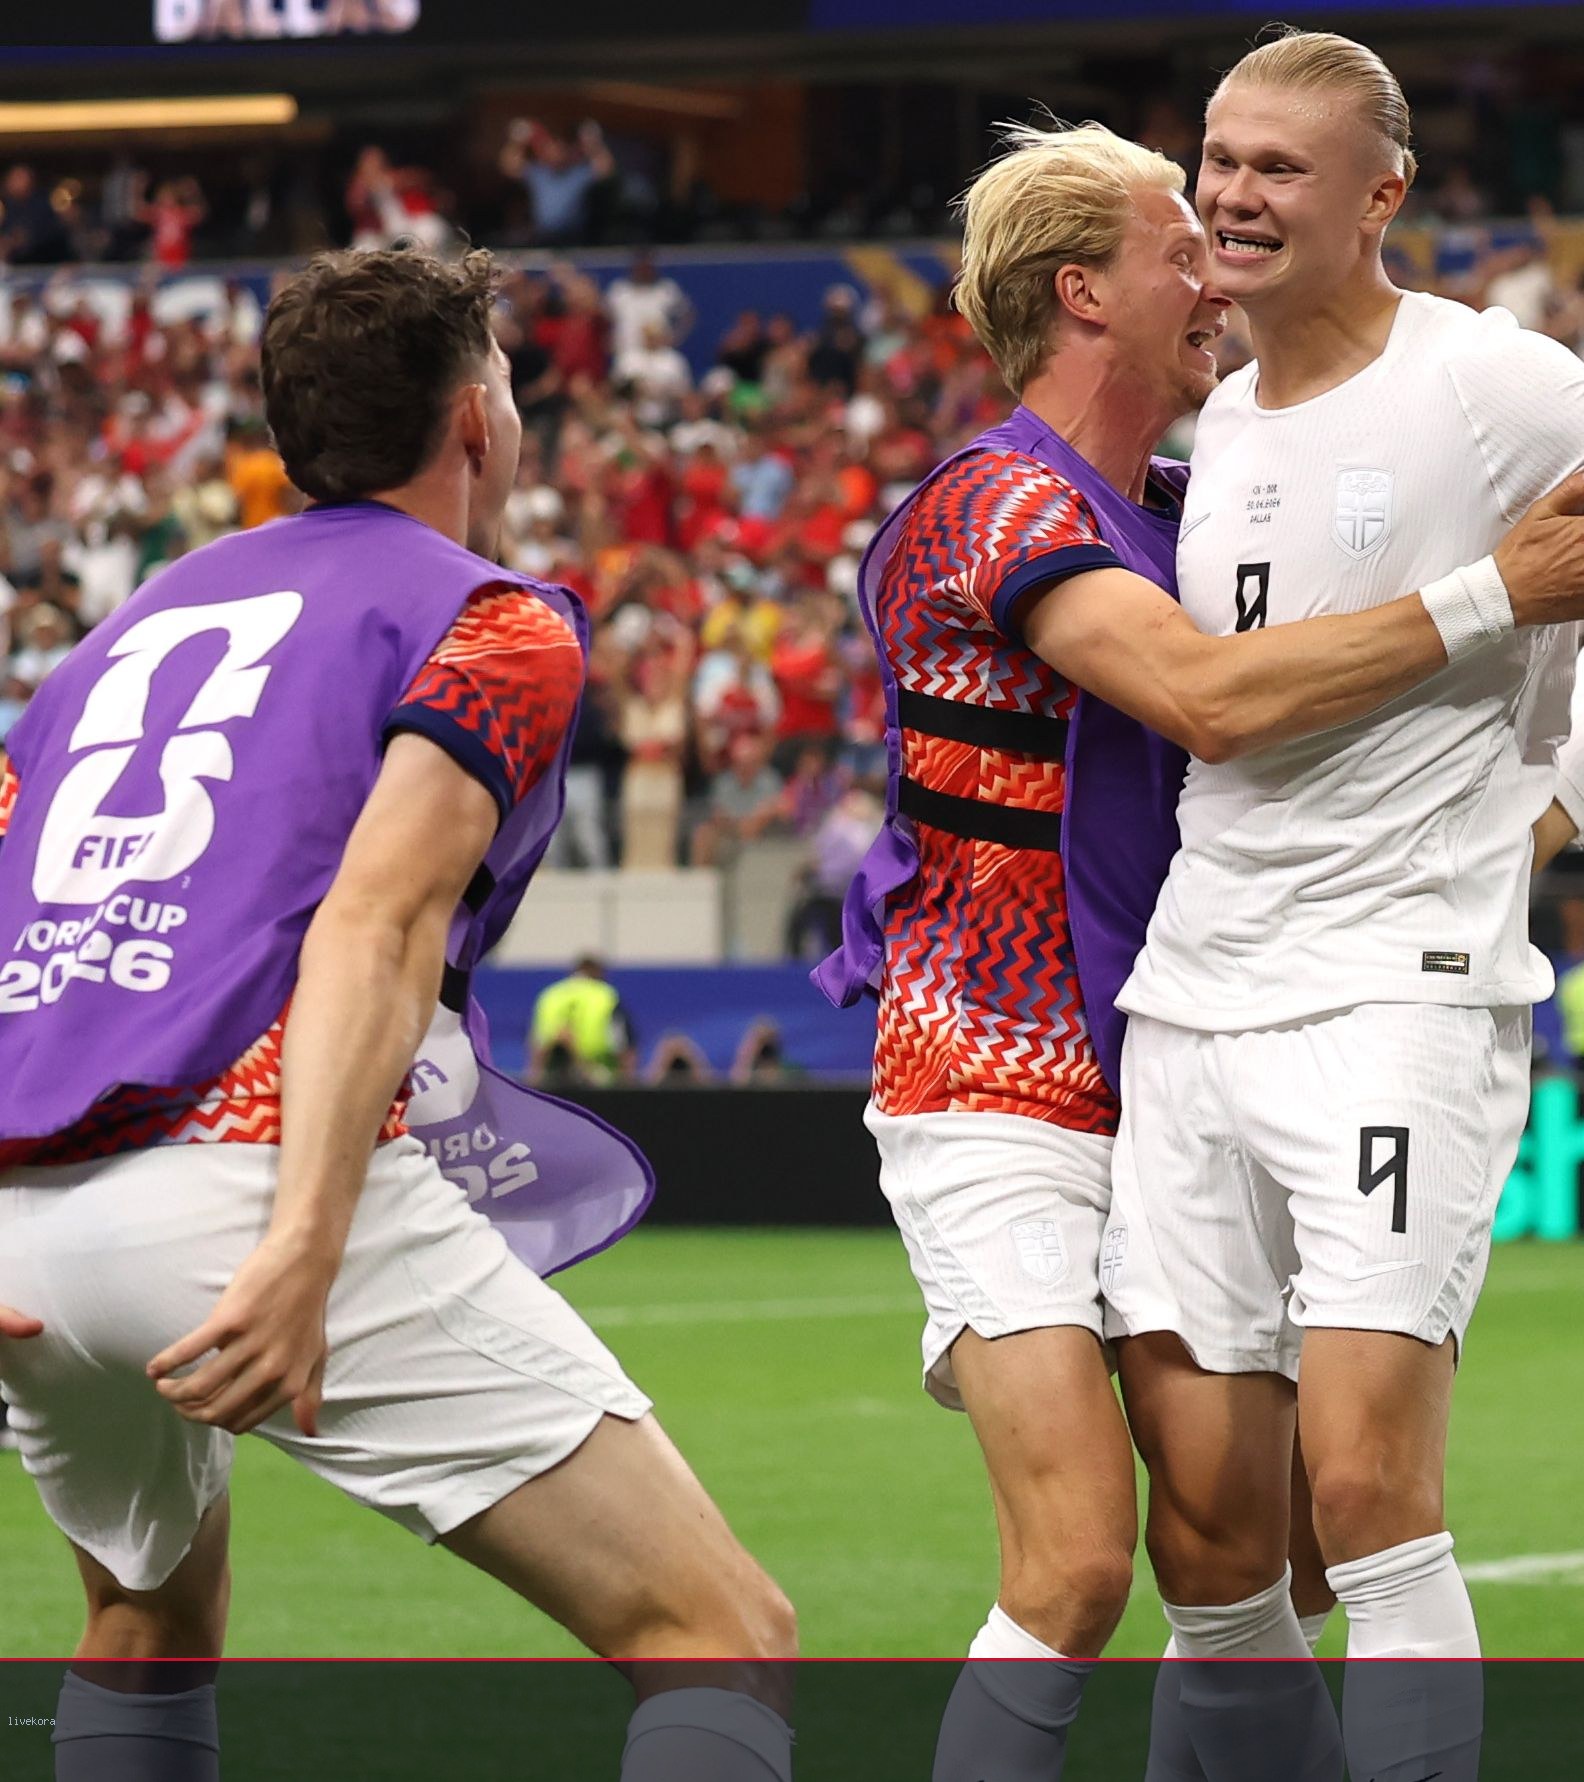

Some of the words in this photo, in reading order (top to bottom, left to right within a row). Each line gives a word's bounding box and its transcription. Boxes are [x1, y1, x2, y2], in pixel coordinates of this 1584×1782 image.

[71, 830, 156, 870] FIF
[103, 893, 188, 934] CUP
[1357, 1126, 1410, 1234] 9
